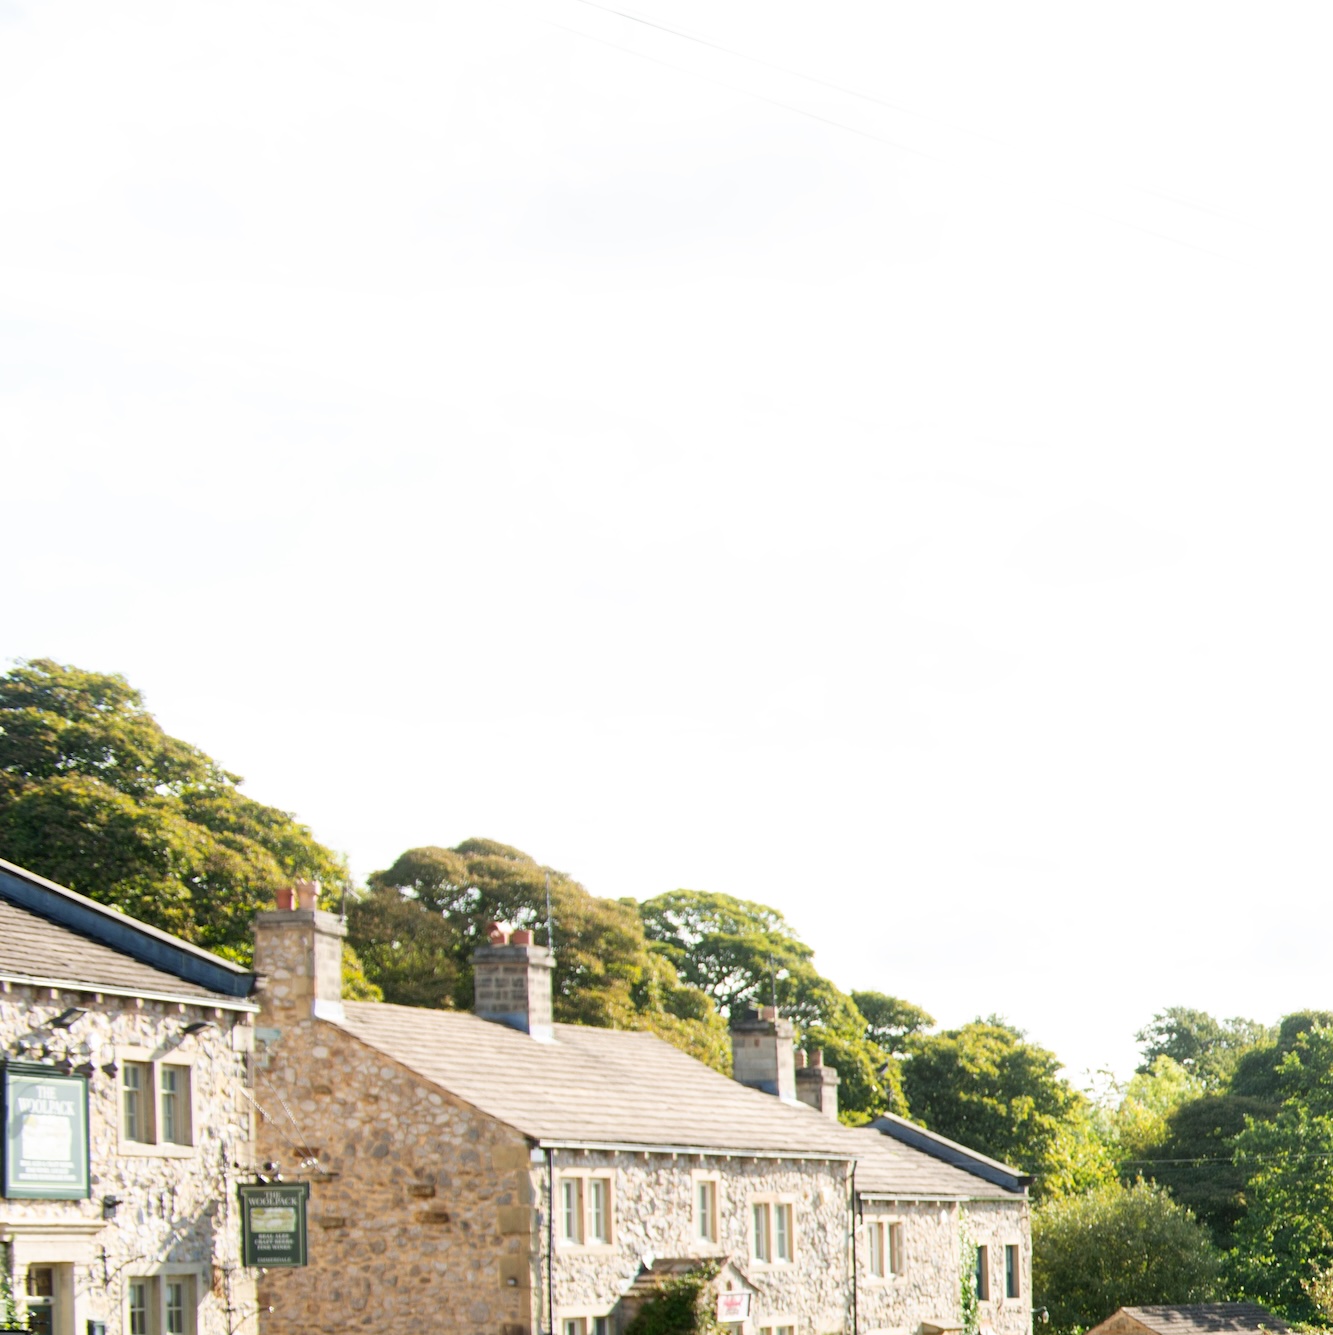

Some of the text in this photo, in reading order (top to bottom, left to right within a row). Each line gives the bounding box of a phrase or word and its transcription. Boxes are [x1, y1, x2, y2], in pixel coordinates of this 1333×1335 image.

[36, 1085, 57, 1100] THE
[17, 1097, 76, 1116] WOOLPACK
[264, 1191, 281, 1199] THE
[248, 1197, 298, 1206] WOOLPACK
